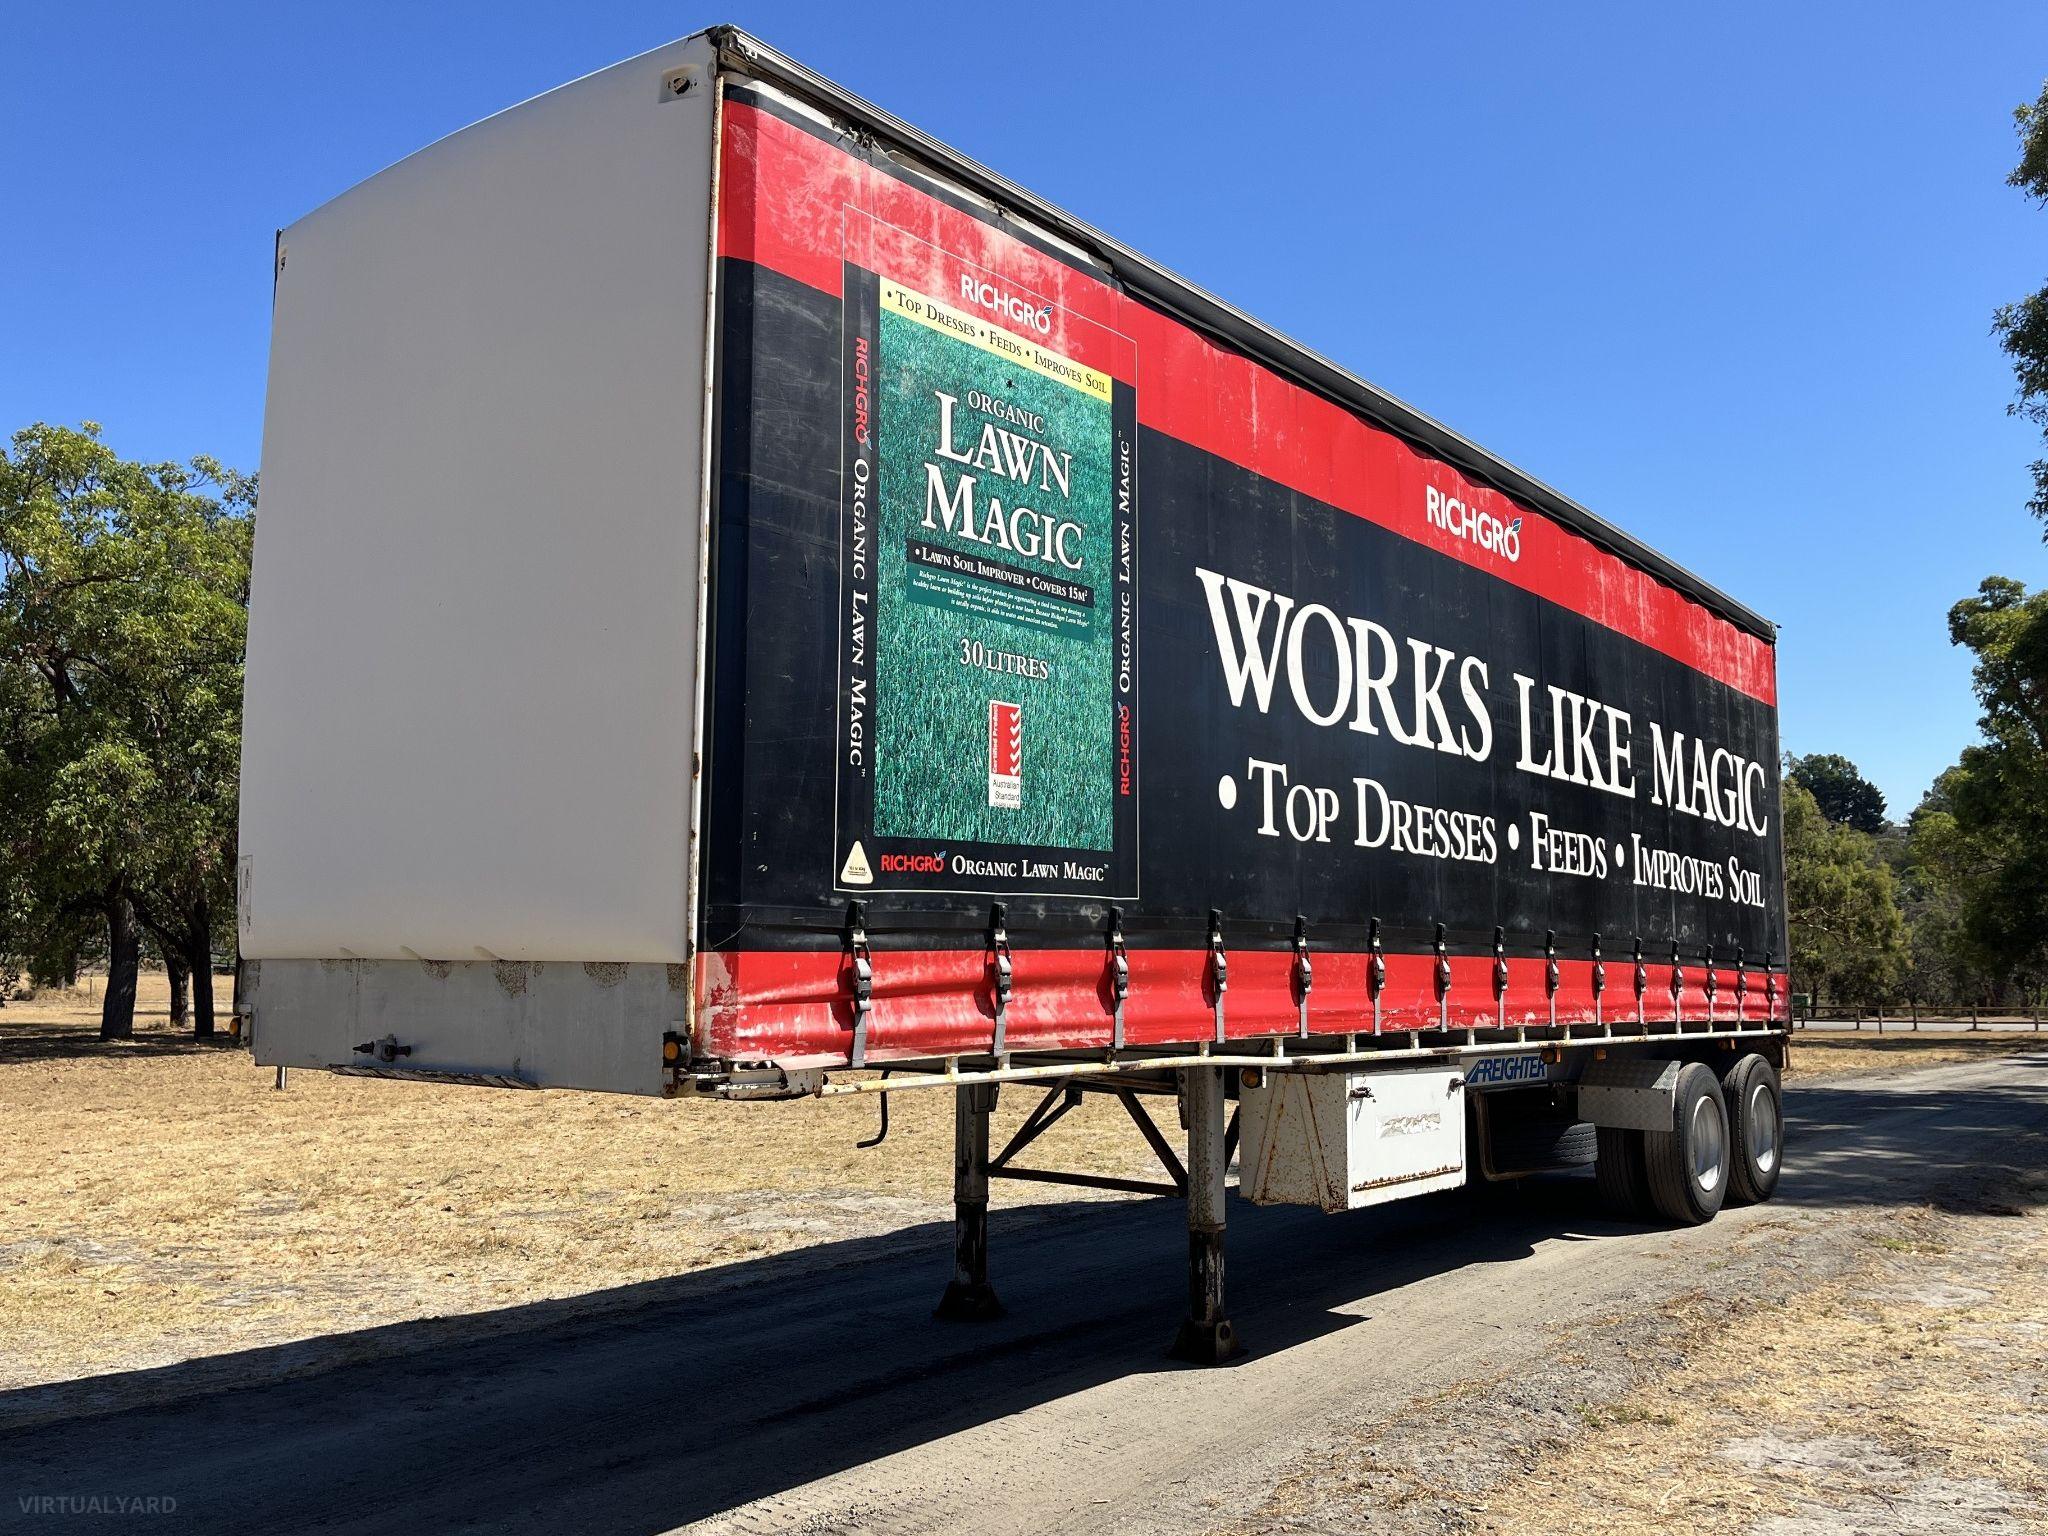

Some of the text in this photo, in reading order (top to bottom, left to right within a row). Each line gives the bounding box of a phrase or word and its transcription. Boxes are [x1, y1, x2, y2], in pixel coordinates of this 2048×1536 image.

[896, 290, 1108, 394] TOP DRESSES FEEDS IMPROVES SOIL
[961, 274, 1051, 335] RICHGRO
[855, 336, 868, 446] RICHGRO
[967, 389, 1045, 434] ORGANIC
[934, 390, 1073, 499] LAWN
[853, 457, 869, 581] ORGANIC
[1119, 520, 1130, 585] LAWN
[1426, 484, 1520, 563] RICHGRO
[922, 546, 951, 567] LAWN
[954, 554, 976, 573] SOIL
[977, 561, 1025, 586] IMPROVER
[1031, 577, 1067, 598] COVERS
[851, 589, 868, 667] LAWN
[959, 638, 1049, 680] 30 LITRES
[1119, 591, 1131, 694] ORGANIC
[1195, 566, 1768, 838] WORKS LIKE MAGIC
[1120, 704, 1131, 796] RICHGRO
[880, 854, 946, 873] RICHGRO
[951, 854, 1017, 878] ORGANIC
[1021, 859, 1059, 879] LAWN
[1247, 756, 1766, 908] TOP DRESSES FEEDS IMPROVES SOIL
[1465, 1055, 1547, 1084] FREIGHTER
